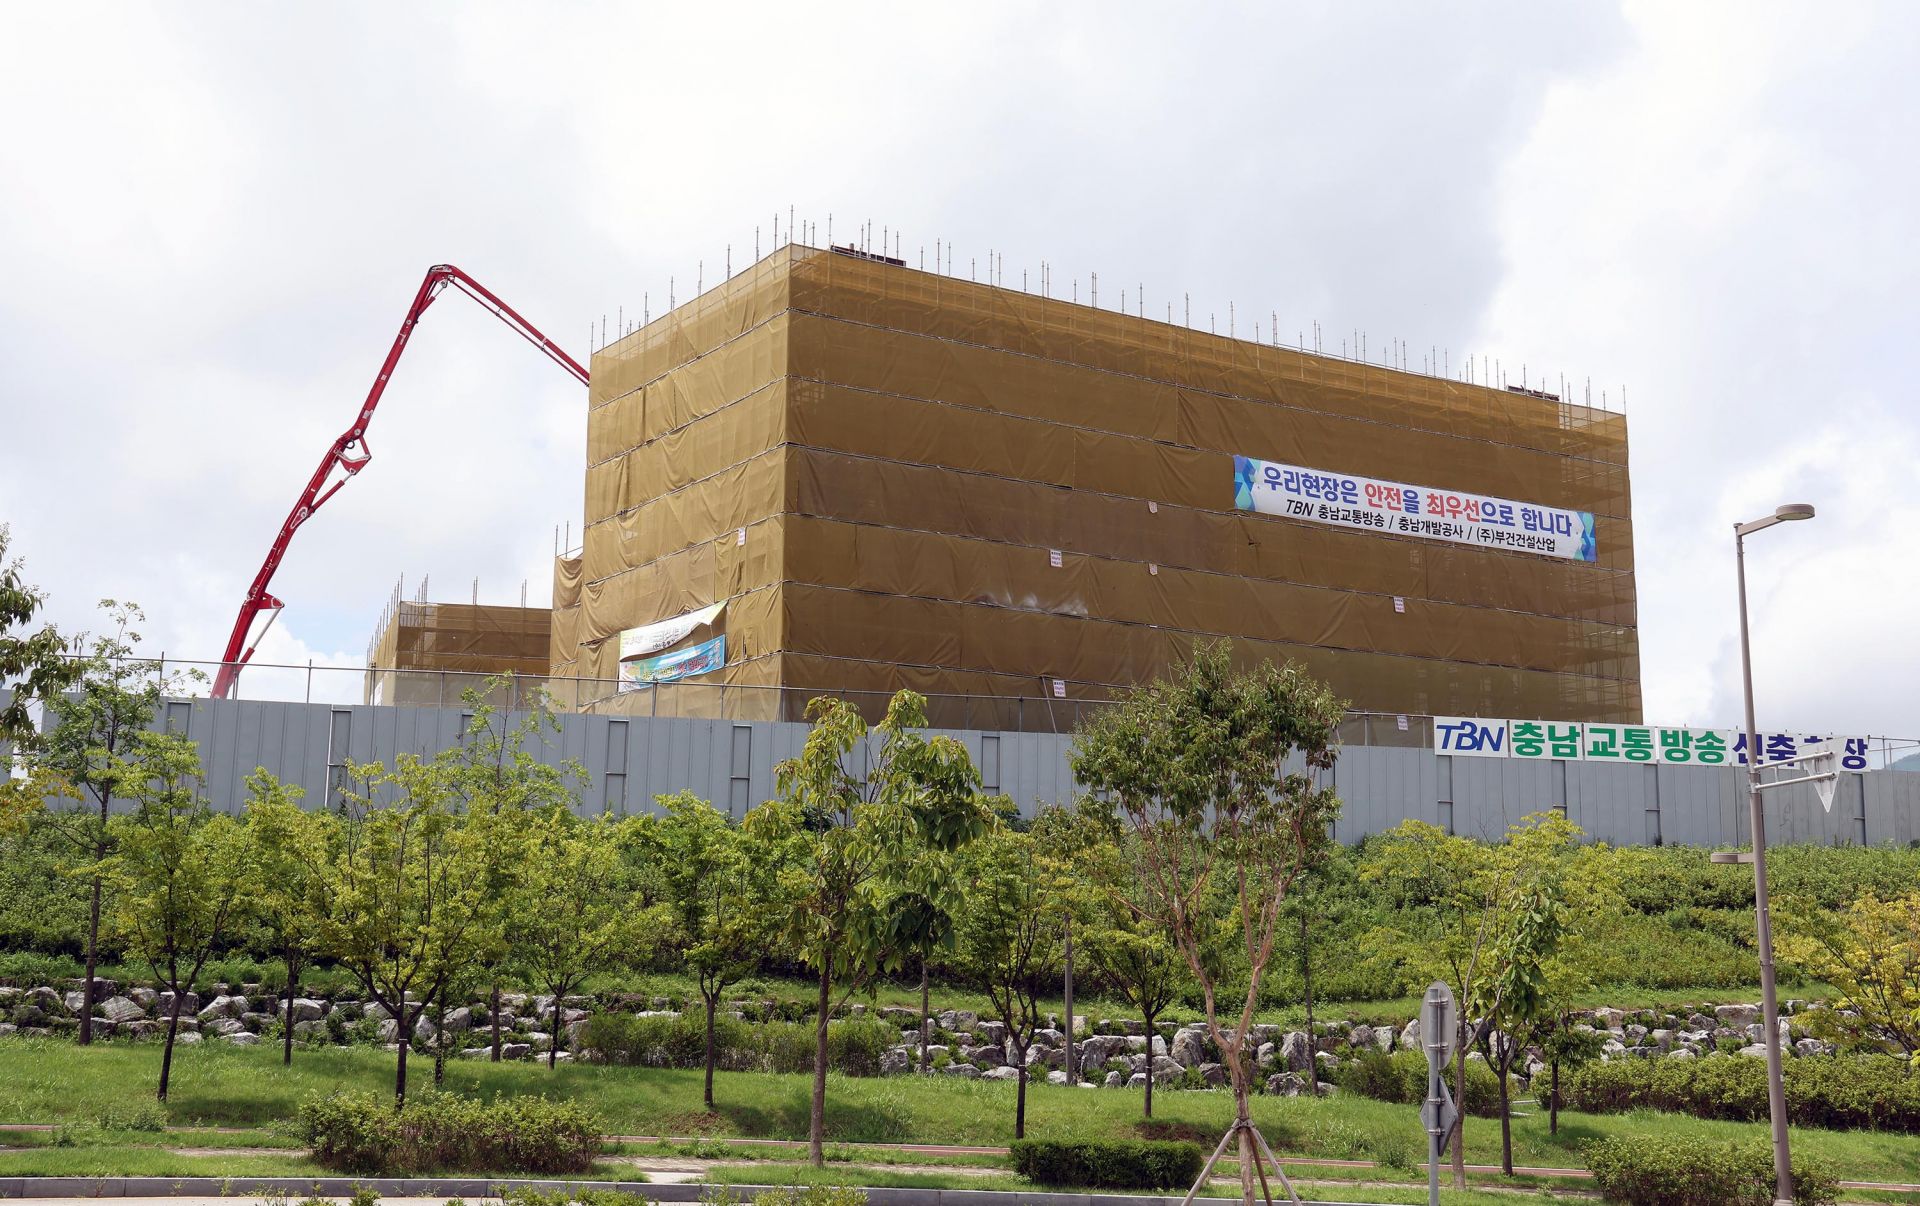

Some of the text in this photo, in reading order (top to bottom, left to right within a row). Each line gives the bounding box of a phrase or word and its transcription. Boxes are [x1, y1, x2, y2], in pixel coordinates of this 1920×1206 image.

[1264, 466, 1572, 537] 우리현장은 안전을 최우선으로 합니다
[1286, 499, 1314, 516] TBN
[1318, 504, 1385, 528] 충남교통방송
[1398, 516, 1463, 538] 충남개발공사
[1476, 526, 1556, 552] (주)부건건설산업
[1436, 721, 1504, 752] TBN
[1732, 733, 1868, 769] 신축장
